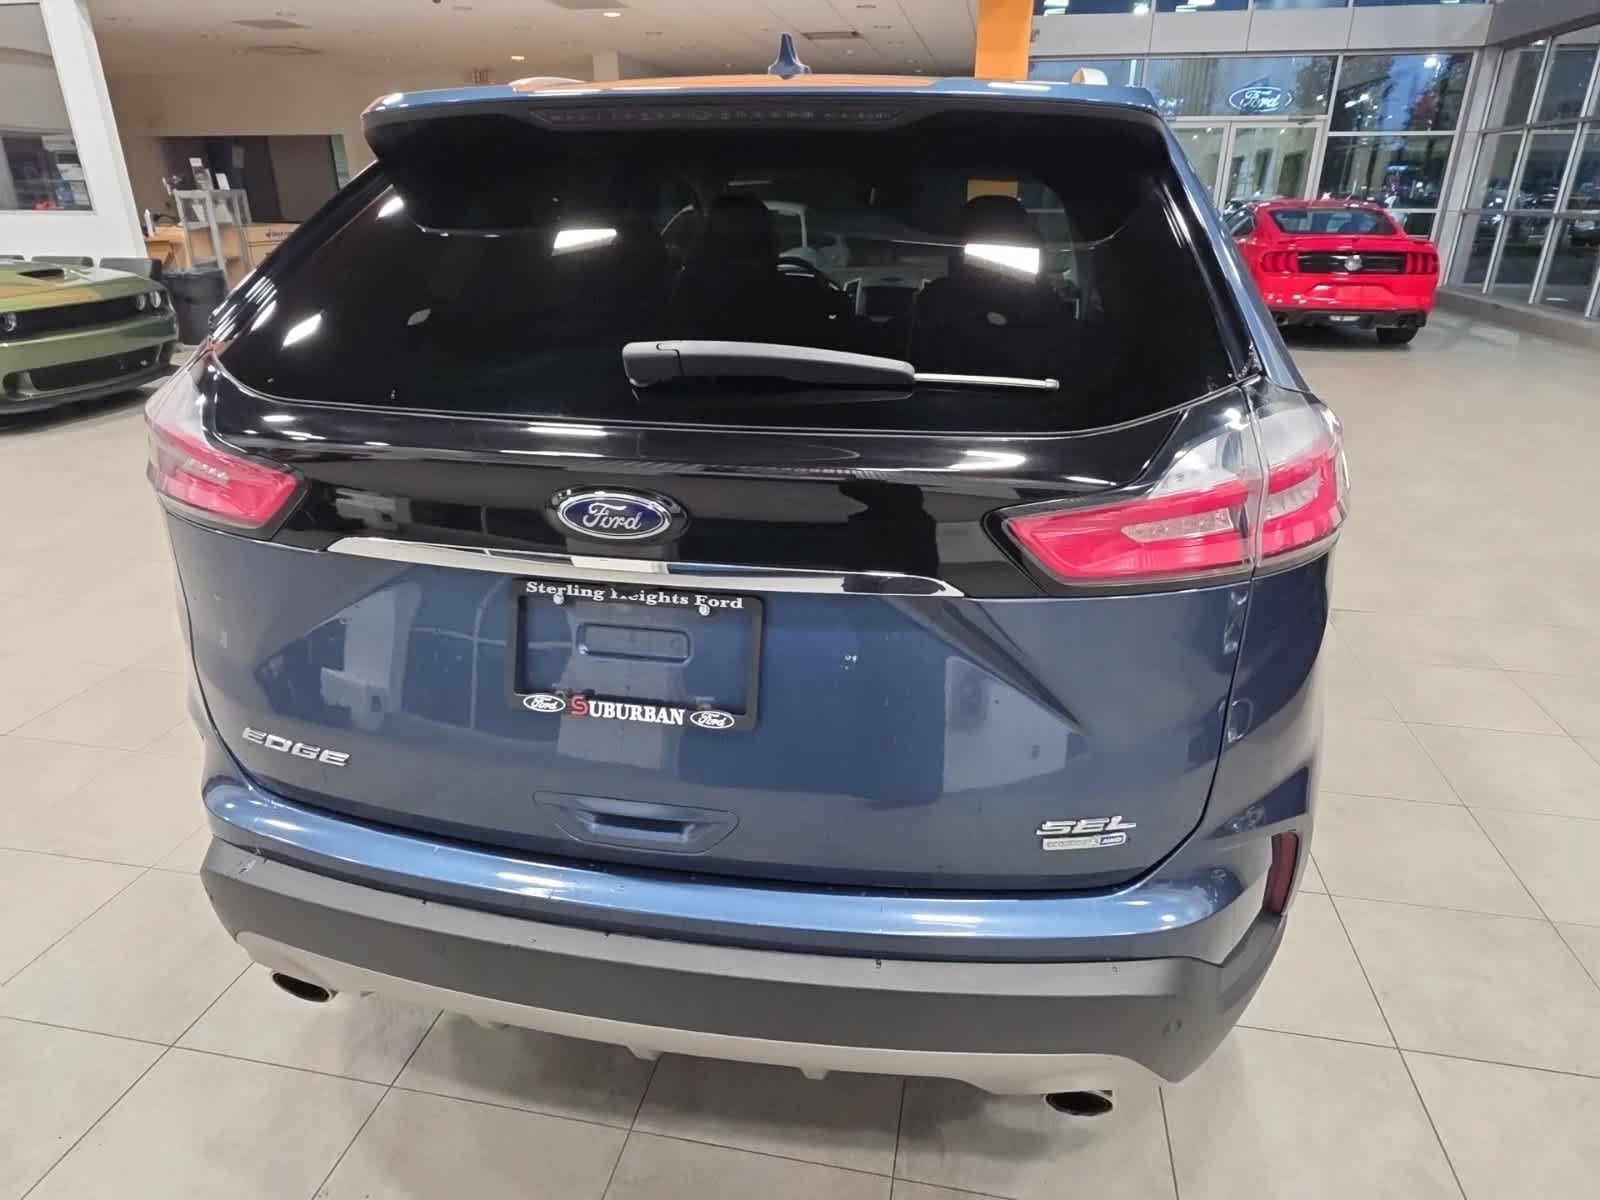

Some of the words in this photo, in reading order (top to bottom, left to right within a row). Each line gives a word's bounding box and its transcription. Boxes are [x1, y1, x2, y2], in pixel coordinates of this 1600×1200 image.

[1240, 89, 1281, 108] Ford
[582, 502, 643, 531] Ford
[526, 581, 605, 601] Sterling
[694, 594, 743, 609] Ford
[571, 695, 686, 726] SUBURBAN
[242, 727, 350, 767] EDGE
[1036, 815, 1137, 836] SEL
